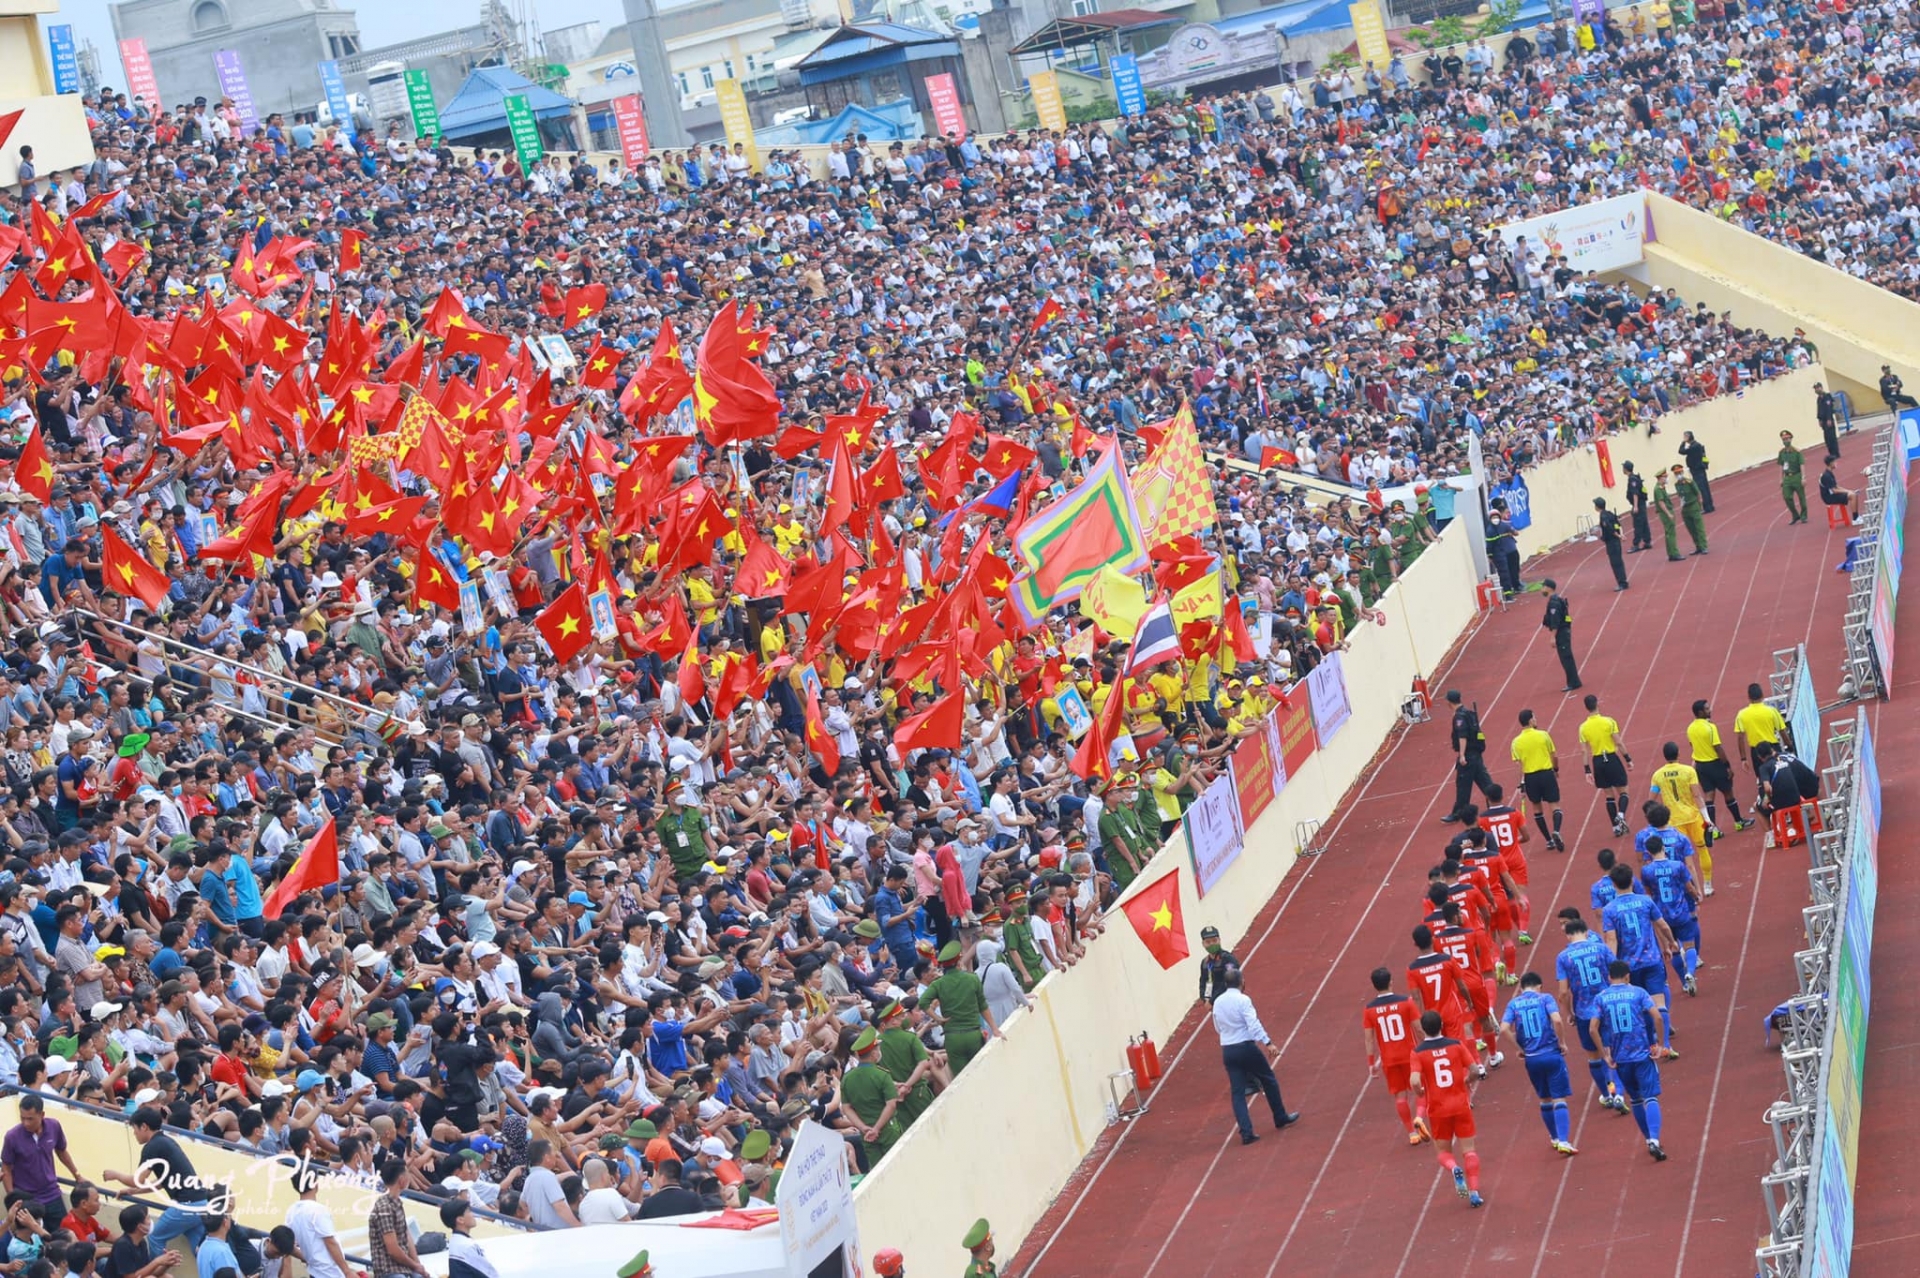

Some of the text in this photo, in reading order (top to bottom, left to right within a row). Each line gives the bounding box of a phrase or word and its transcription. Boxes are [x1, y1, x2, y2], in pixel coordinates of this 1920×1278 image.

[423, 125, 436, 134] 2021
[524, 150, 538, 159] 2021
[630, 151, 644, 160] 2021
[1670, 779, 1679, 802] 1
[1490, 822, 1514, 847] 19
[1658, 877, 1673, 903] 6
[1624, 913, 1641, 939] 4
[1574, 956, 1601, 987] 16
[1425, 973, 1442, 1001] 7
[1377, 1013, 1406, 1042] 10
[1520, 1009, 1542, 1038] 10
[1607, 1003, 1633, 1034] 18
[1434, 1058, 1454, 1088] 6
